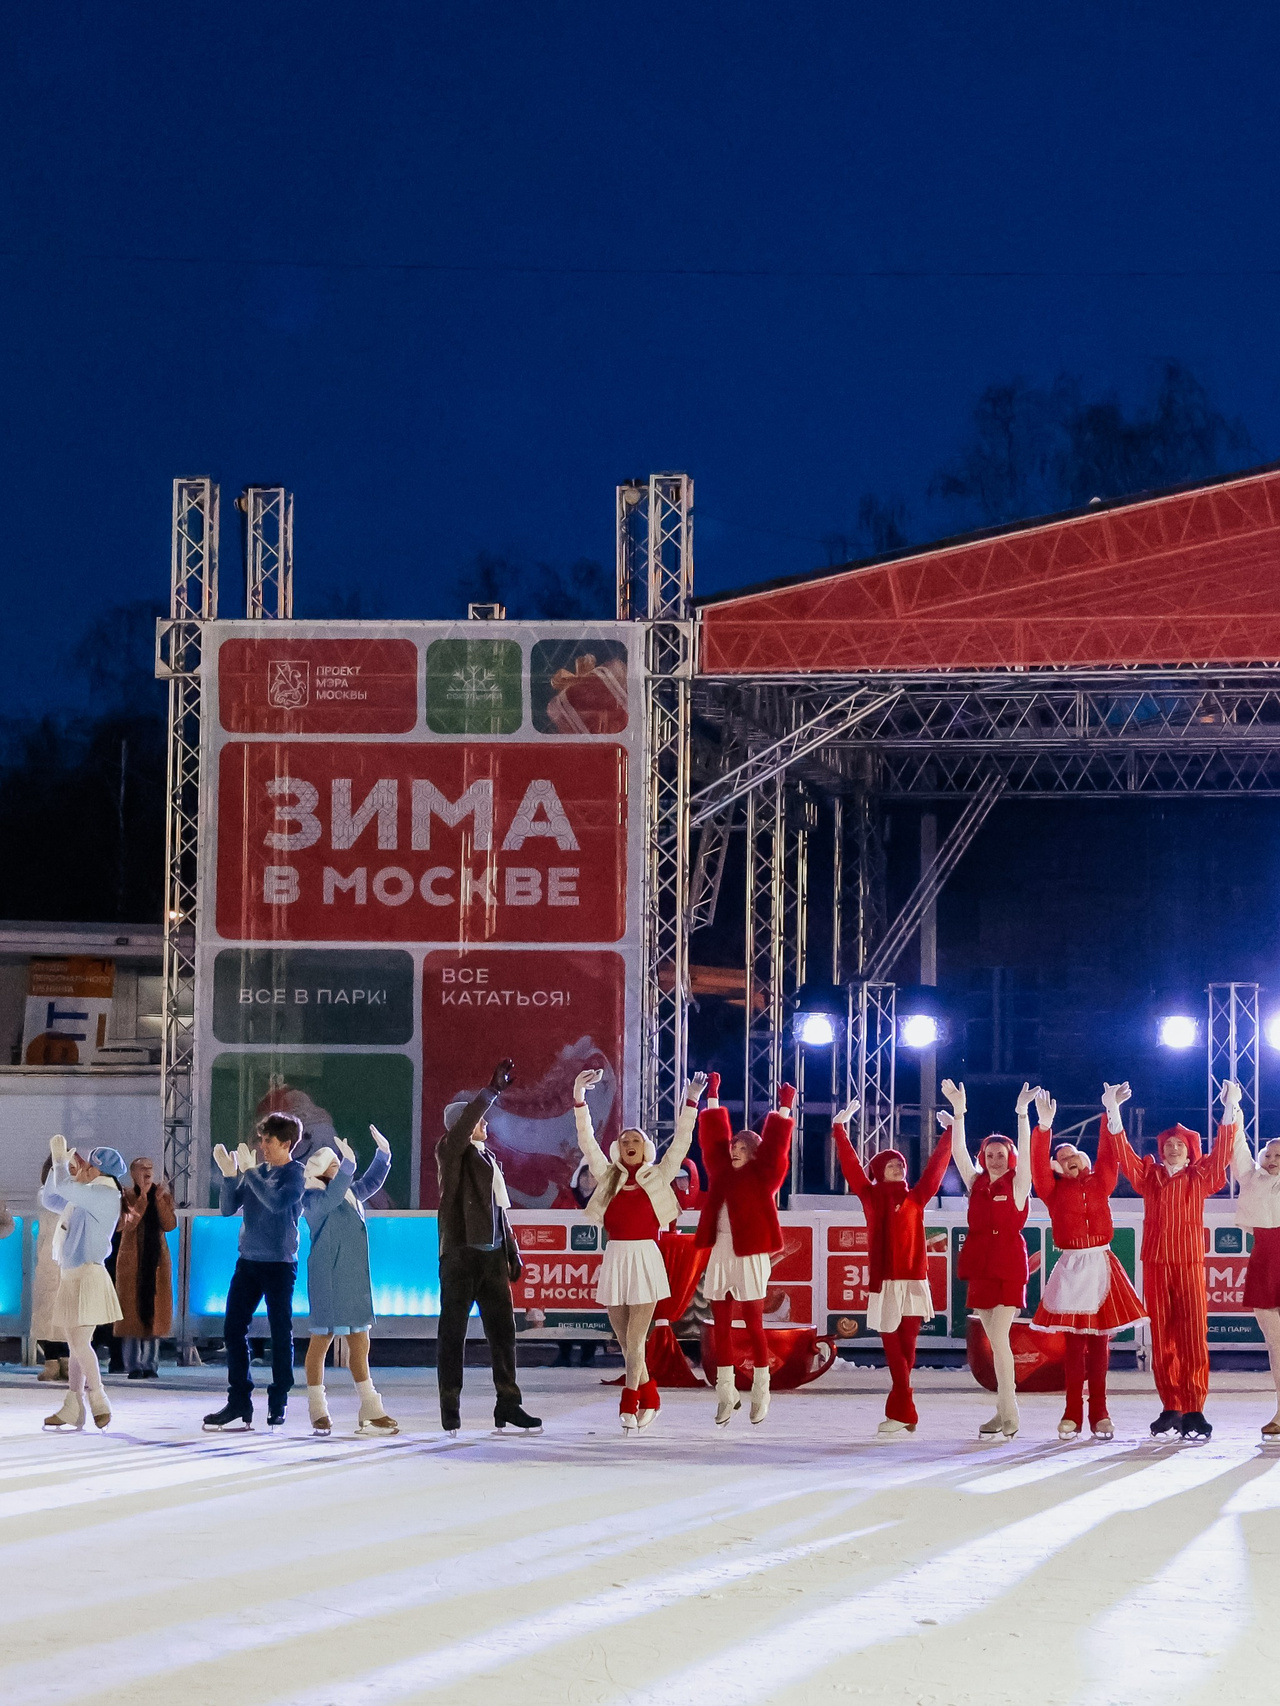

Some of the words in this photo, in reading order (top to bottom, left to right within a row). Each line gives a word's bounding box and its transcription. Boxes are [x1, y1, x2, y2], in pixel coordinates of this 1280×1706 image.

[316, 666, 361, 676] ПРОЕКТ
[316, 678, 349, 688] МЭРА
[316, 690, 368, 700] МОСКВЫ
[263, 776, 582, 851] ЗИМА
[263, 866, 301, 905] В
[322, 866, 581, 906] МОСКВЕ
[442, 968, 489, 984] ВСЕ
[239, 988, 286, 1005] ВСЕ
[294, 988, 309, 1005] В
[317, 988, 387, 1005] ПАРК!
[442, 990, 571, 1006] КАТАТЬСЯ!
[524, 1287, 535, 1299] В
